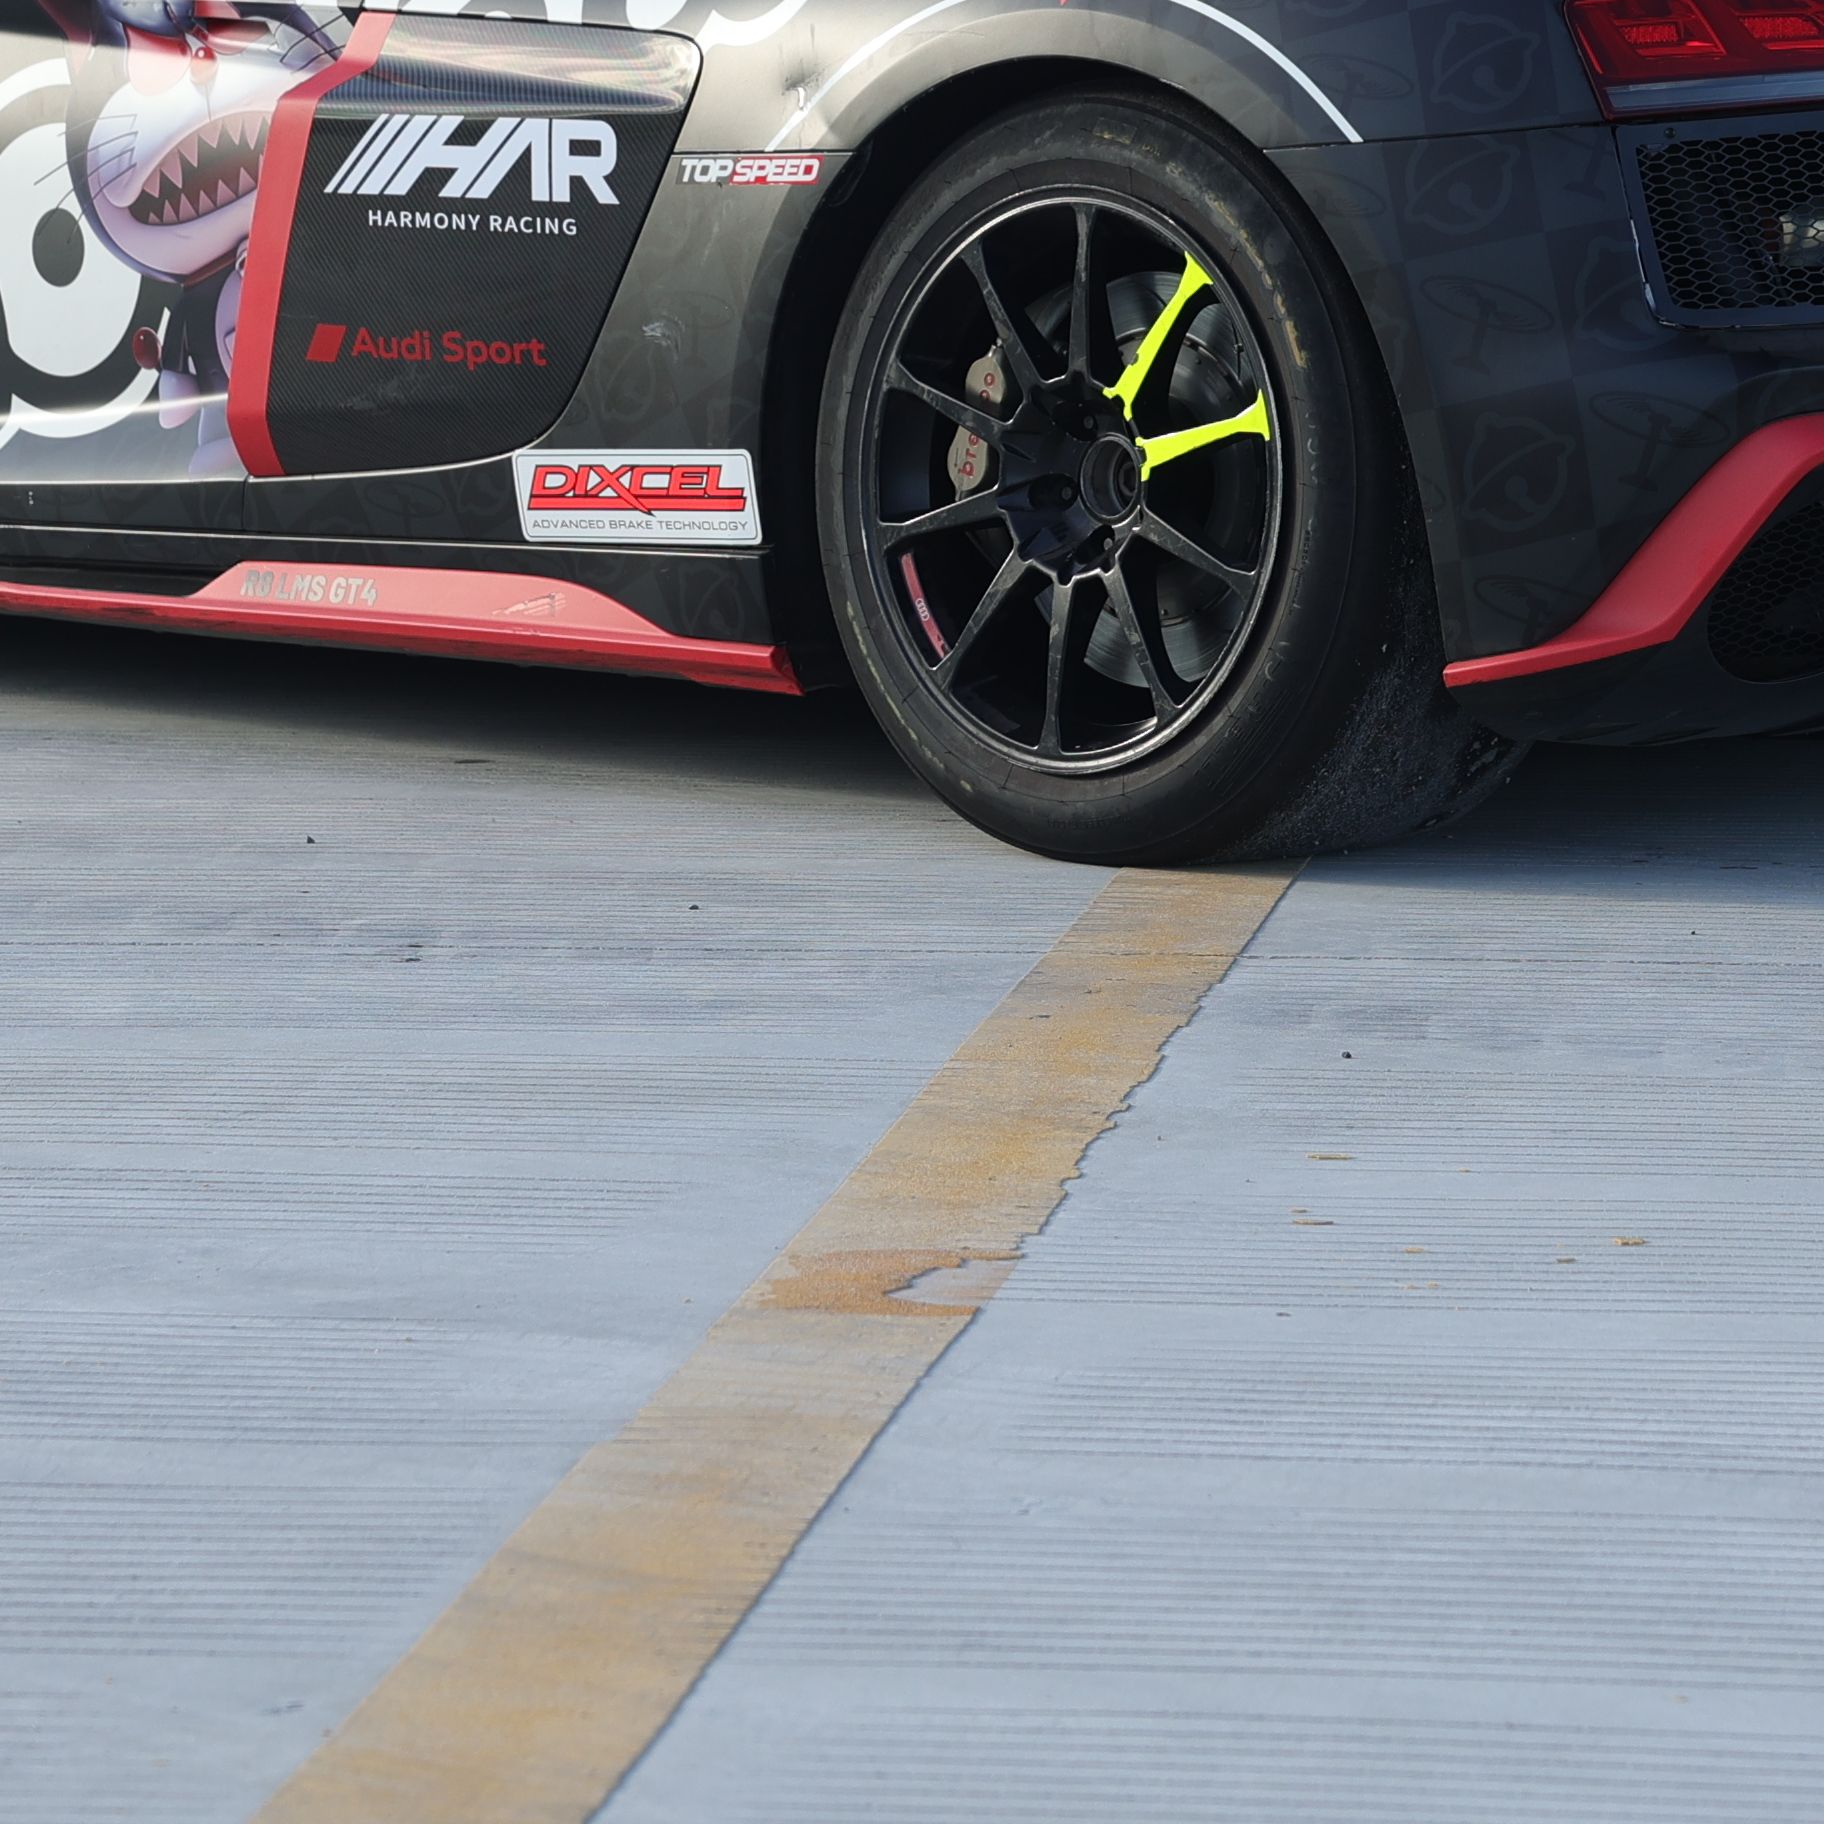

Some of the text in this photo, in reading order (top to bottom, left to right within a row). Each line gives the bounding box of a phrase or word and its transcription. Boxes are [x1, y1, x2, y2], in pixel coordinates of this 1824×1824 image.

[374, 115, 620, 205] HAR
[681, 157, 822, 184] TOP SPEED
[367, 209, 578, 236] HARMONY RACING
[351, 327, 549, 371] Audi Sport
[529, 464, 747, 511] DIXCEL
[532, 518, 748, 533] ADVANCED BRAKE TECHNOLOGY
[240, 570, 378, 606] R8 LMS GT4
